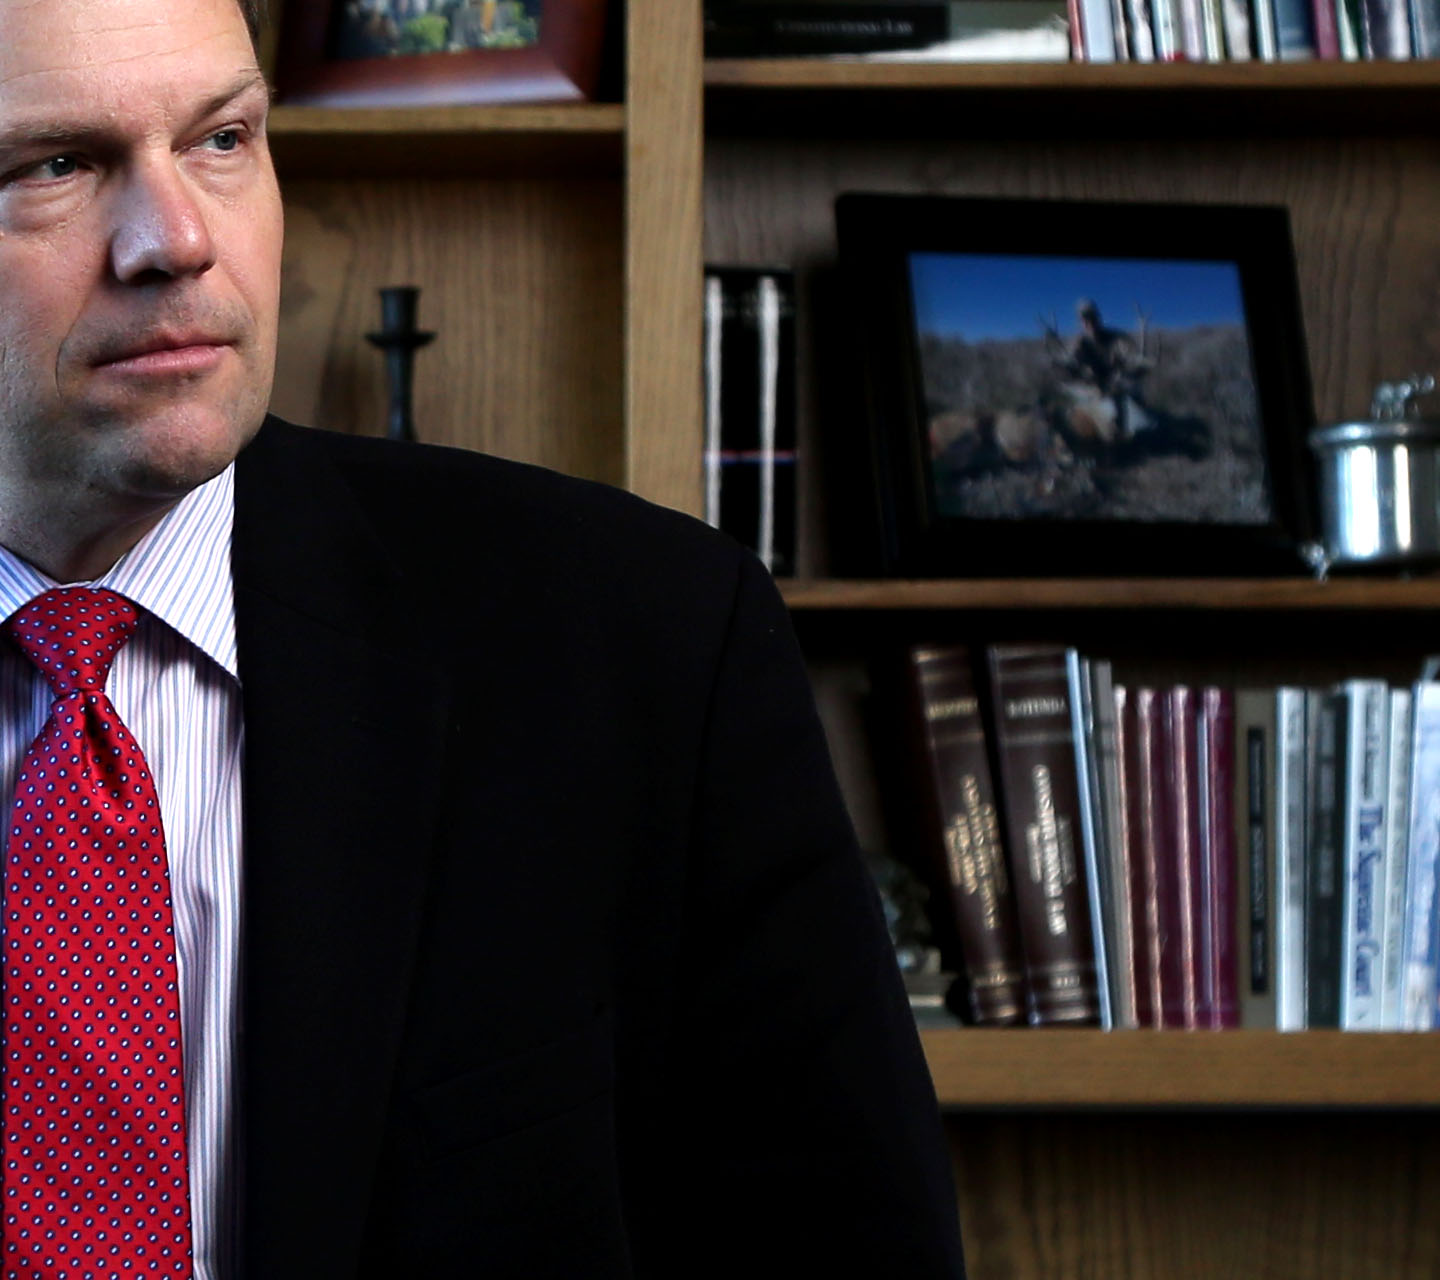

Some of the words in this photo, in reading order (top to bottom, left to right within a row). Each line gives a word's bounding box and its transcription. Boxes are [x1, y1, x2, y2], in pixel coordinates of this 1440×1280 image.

[1358, 805, 1383, 844] The
[1352, 849, 1383, 935] Supreme
[1354, 939, 1381, 998] Court
